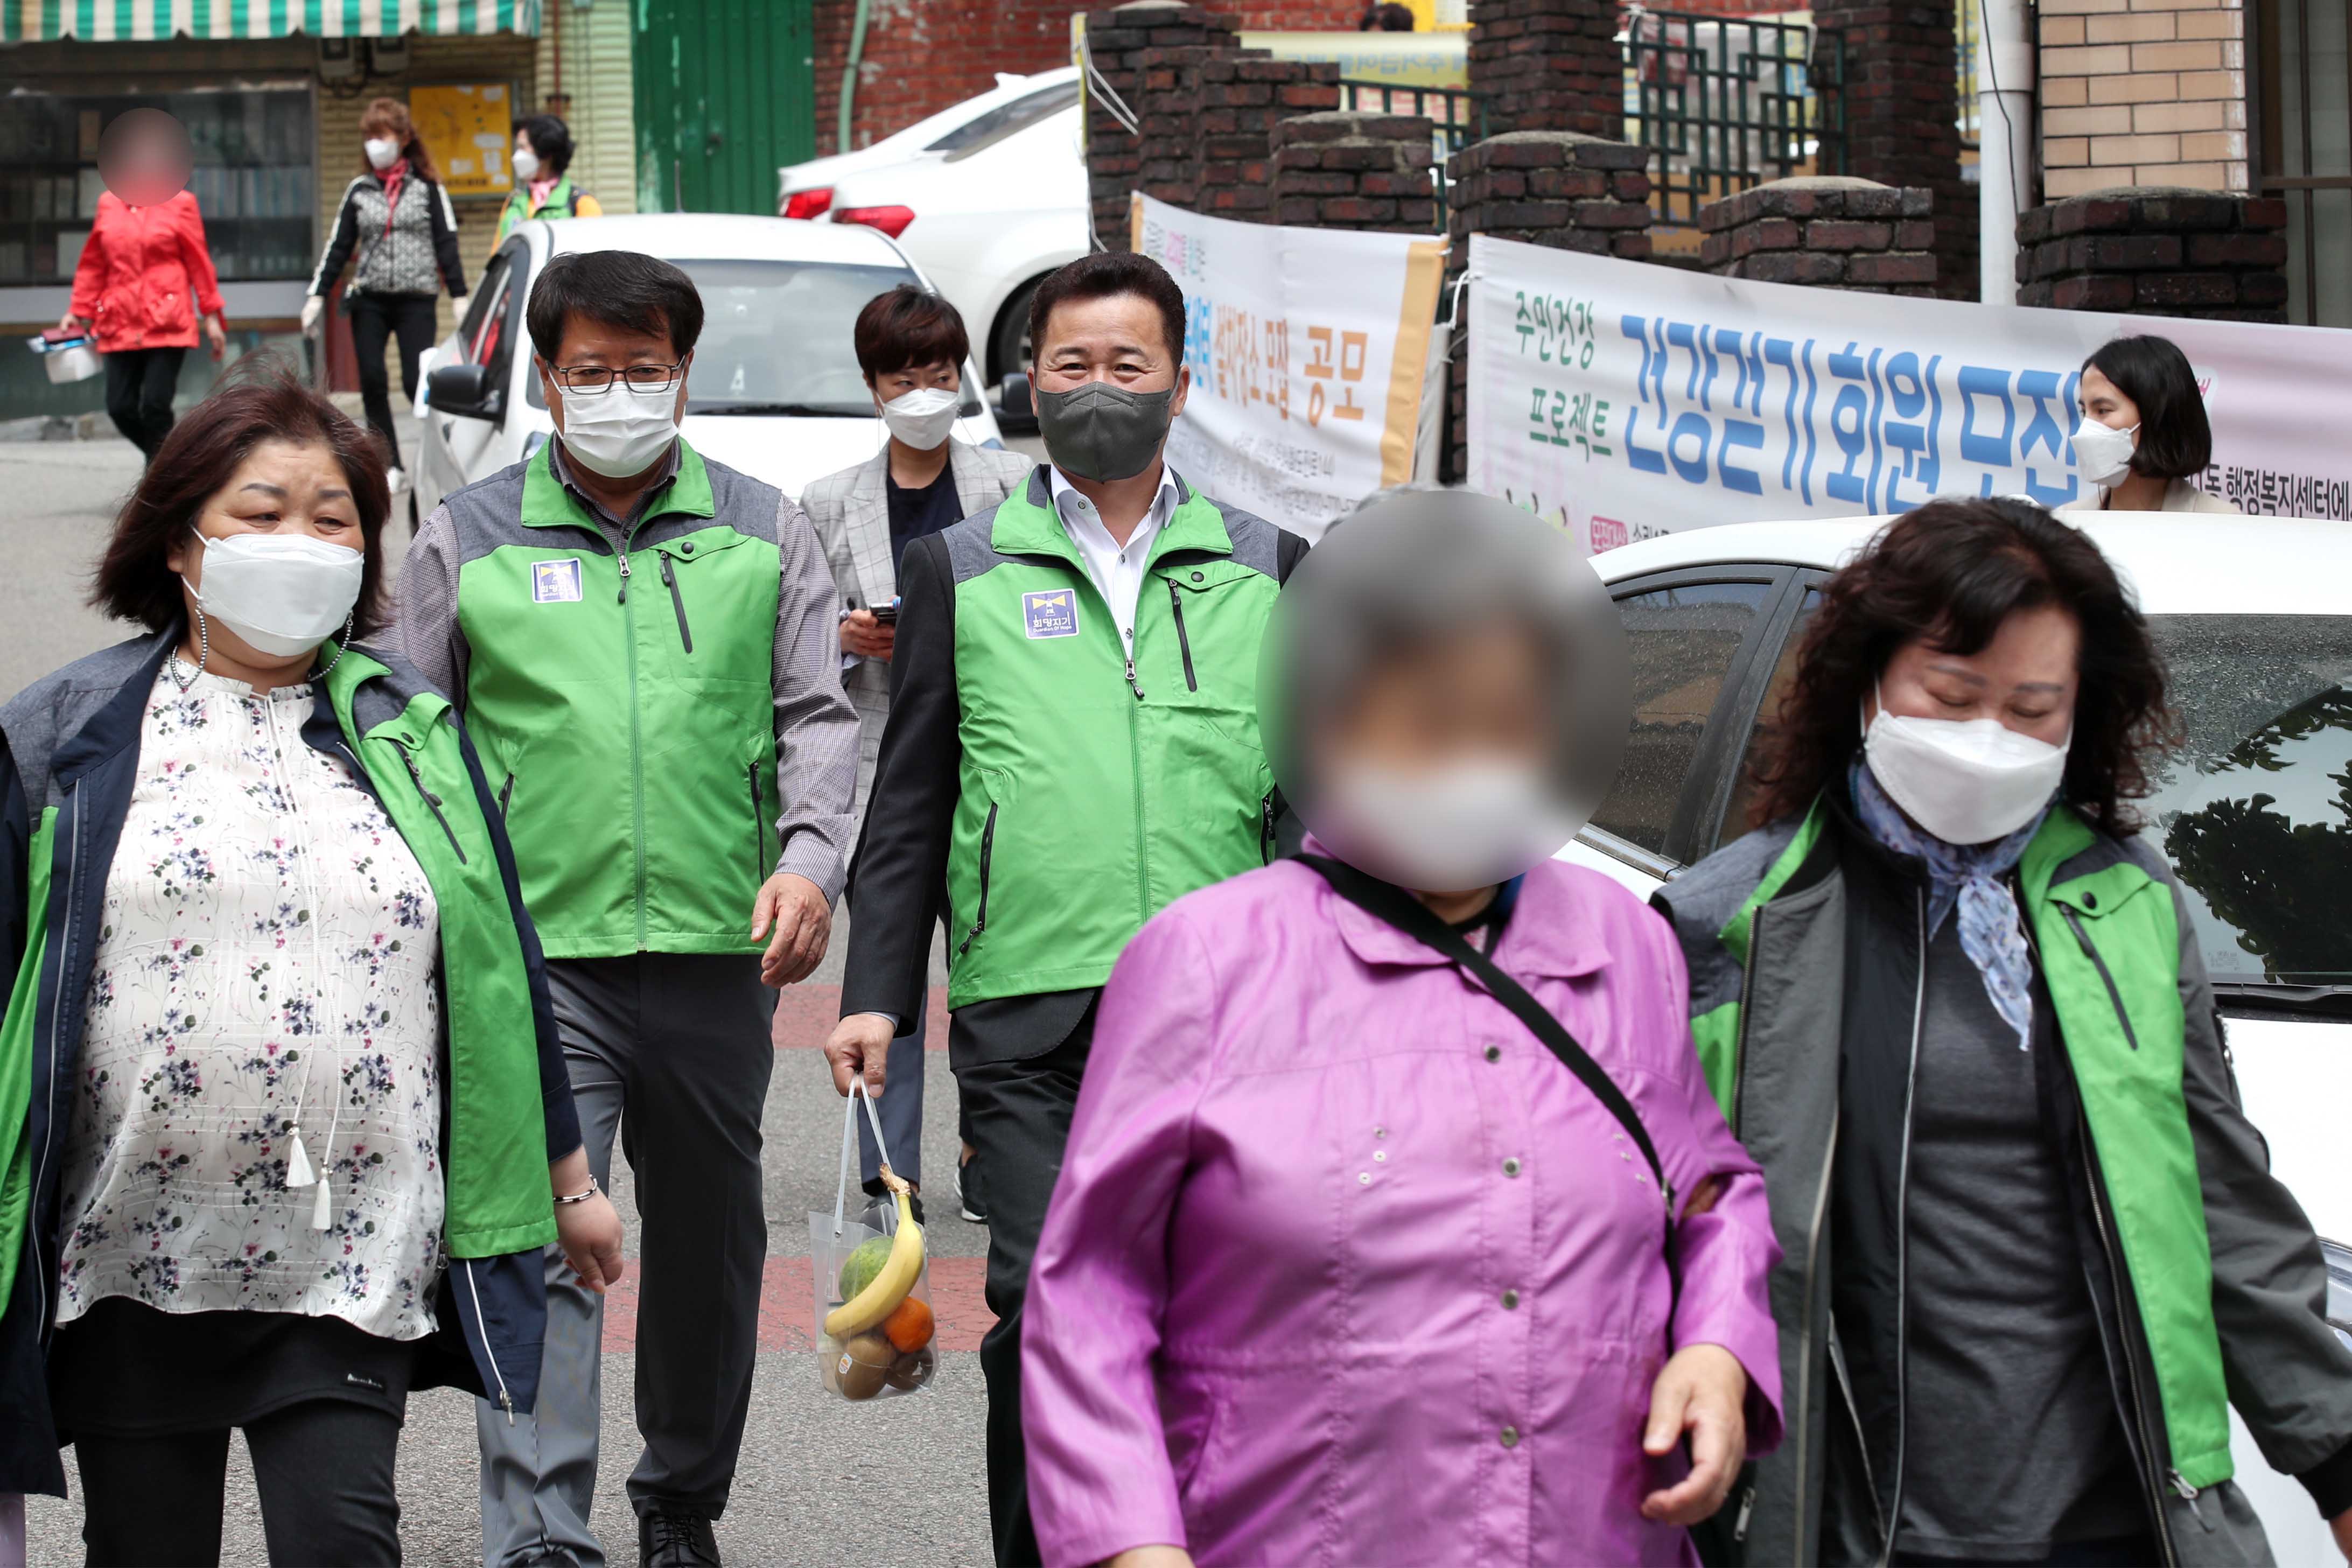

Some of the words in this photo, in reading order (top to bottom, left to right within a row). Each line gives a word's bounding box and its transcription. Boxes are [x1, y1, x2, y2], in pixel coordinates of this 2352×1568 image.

[1516, 291, 1594, 369] 주민건강
[1304, 325, 1368, 428] 공모
[1530, 387, 1612, 463] 프로젝트
[1958, 366, 2080, 508] 모집
[2226, 466, 2352, 521] 행정복지센터에
[1033, 611, 1070, 627] 희망지기
